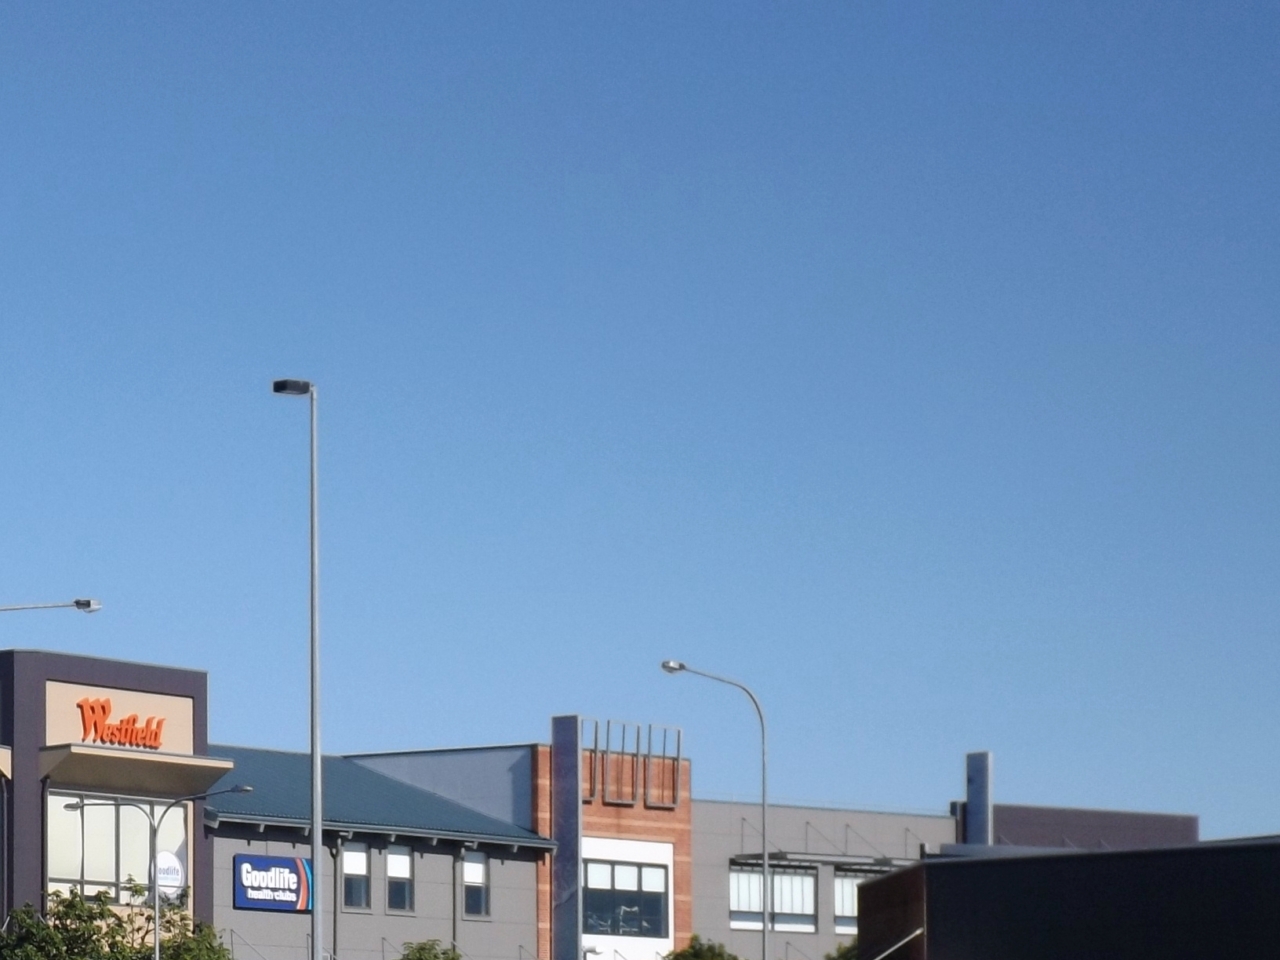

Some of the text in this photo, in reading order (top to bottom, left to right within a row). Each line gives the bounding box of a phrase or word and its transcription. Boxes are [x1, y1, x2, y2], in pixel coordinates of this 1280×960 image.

[76, 697, 166, 750] Westfield
[158, 866, 180, 877] oodlife
[241, 862, 298, 890] Goodlife
[247, 887, 297, 902] health clubs
